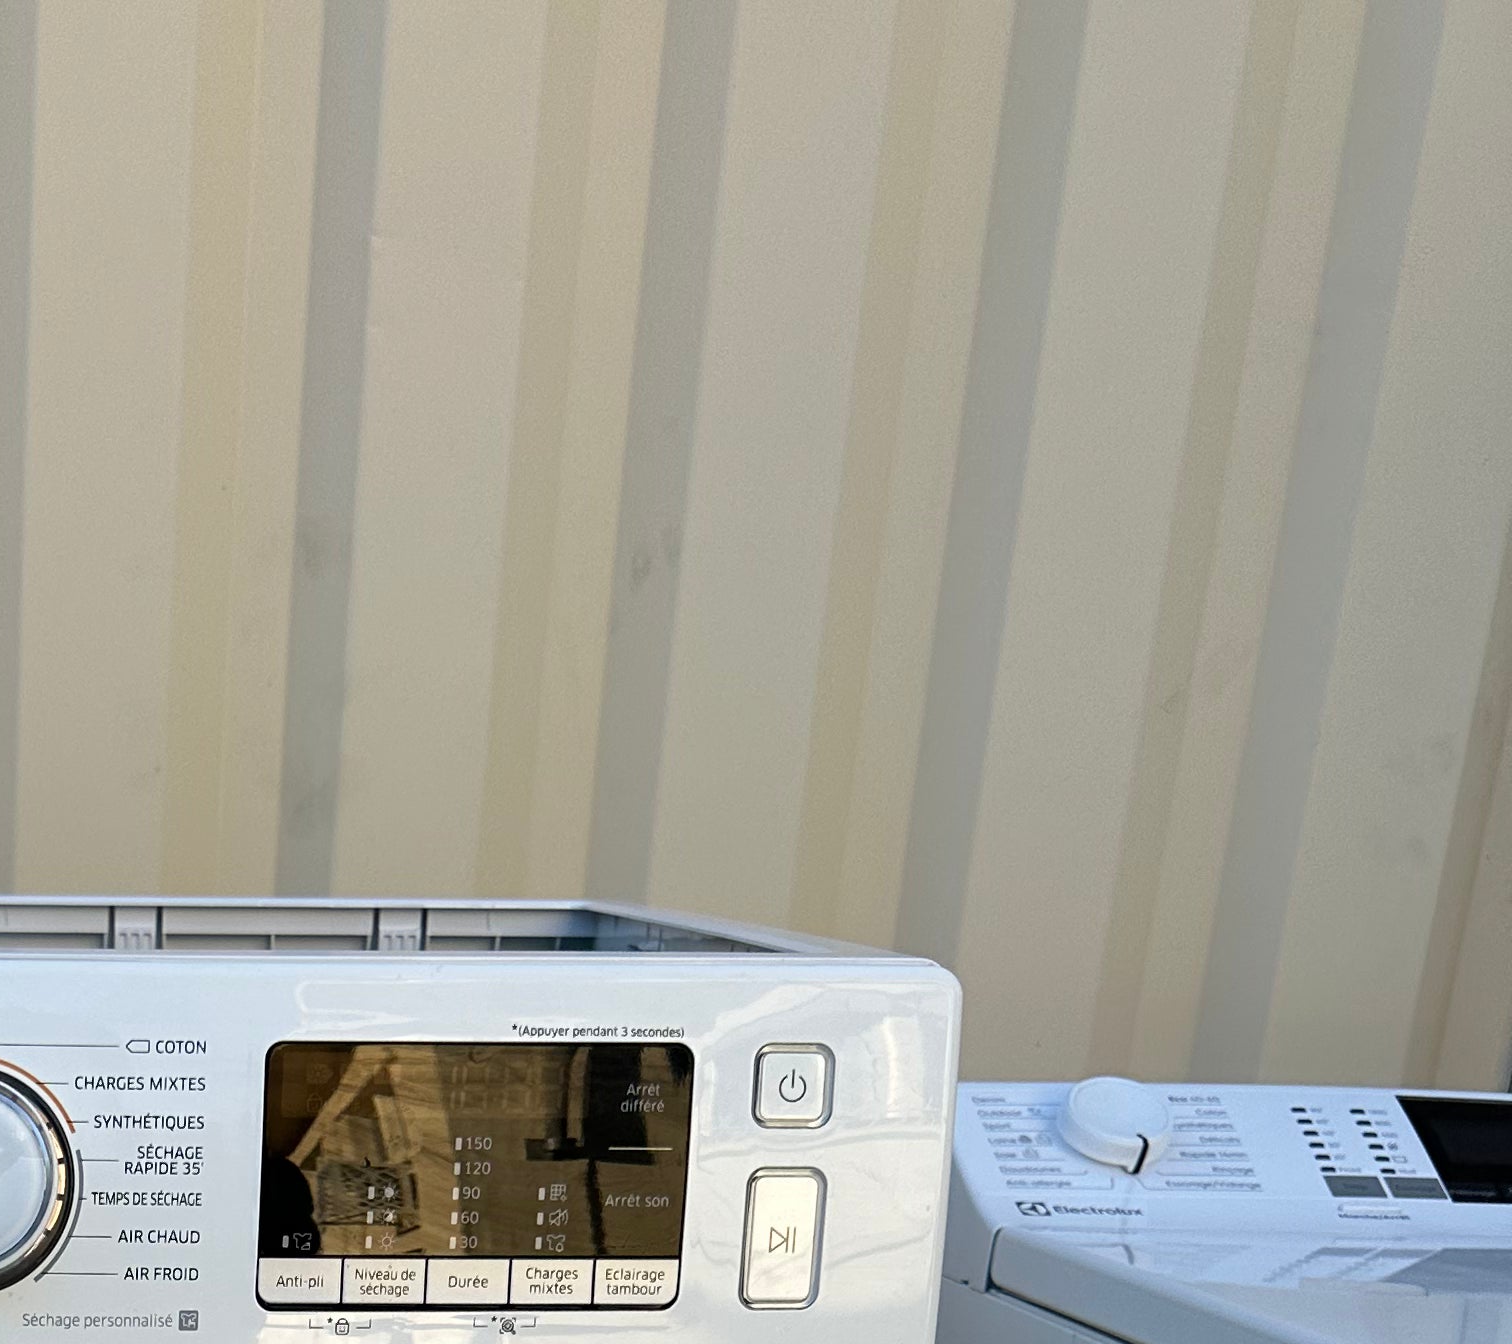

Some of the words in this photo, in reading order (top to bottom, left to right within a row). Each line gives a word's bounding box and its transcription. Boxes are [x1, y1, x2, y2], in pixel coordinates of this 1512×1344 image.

[572, 1026, 618, 1038] pendant
[621, 1027, 628, 1037] 3
[631, 1027, 685, 1038] secondes)
[156, 1040, 207, 1054] COTON
[74, 1076, 145, 1091] CHARGES
[150, 1077, 206, 1091] MIXTES
[626, 1083, 660, 1097] Arrêt
[620, 1099, 664, 1112] différé
[94, 1112, 205, 1131] SYNTHÉTIQUES
[466, 1137, 493, 1150] 150
[137, 1144, 203, 1160] SÉCHAGE
[124, 1162, 178, 1175] RAPIDE
[465, 1162, 491, 1175] 120
[91, 1191, 130, 1206] TEMPS
[133, 1192, 148, 1206] DE
[150, 1190, 202, 1206] SÉCHAGE
[462, 1186, 481, 1200] 90
[604, 1194, 640, 1207] Arrêt
[645, 1196, 669, 1207] son
[461, 1211, 479, 1224] 60
[1053, 1206, 1144, 1216] Electrolux
[118, 1230, 143, 1244] AIR
[148, 1230, 200, 1244] CHAUD
[460, 1236, 478, 1249] 30
[124, 1267, 149, 1281] AIR
[154, 1267, 199, 1281] FROID
[355, 1269, 398, 1281] Niveau
[400, 1269, 416, 1281] de
[526, 1267, 578, 1282] Charges
[605, 1268, 665, 1283] Eclairage
[275, 1275, 324, 1289] Anti-pli
[448, 1275, 489, 1288] Durée
[359, 1283, 410, 1297] séchage
[529, 1283, 573, 1295] mixtes
[606, 1283, 661, 1296] tambour
[22, 1313, 80, 1329] Séchage
[84, 1313, 173, 1329] personnalisé
